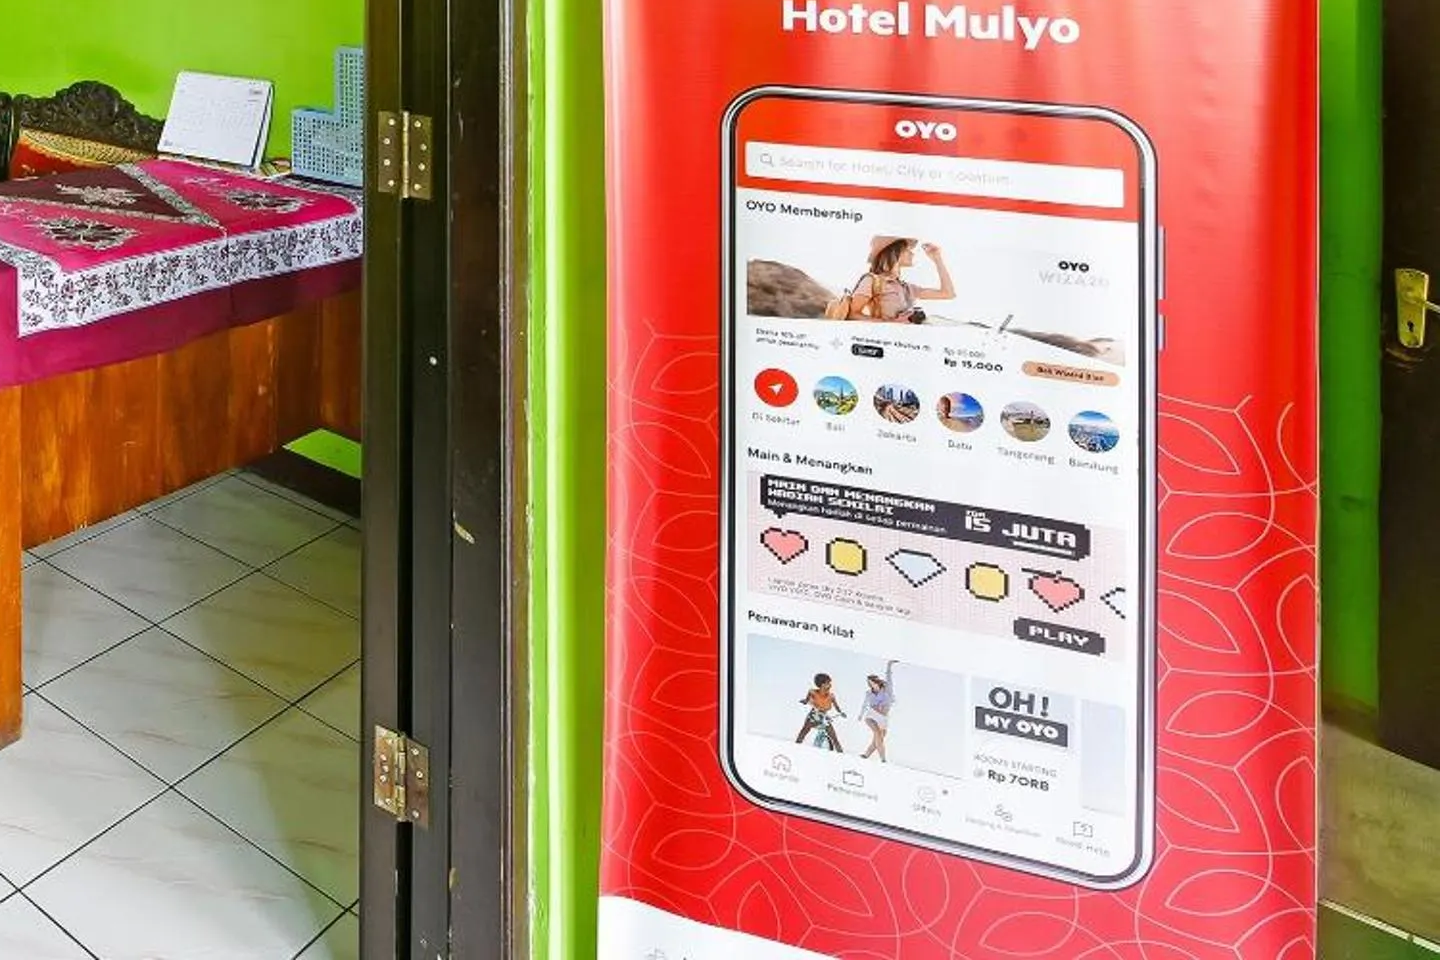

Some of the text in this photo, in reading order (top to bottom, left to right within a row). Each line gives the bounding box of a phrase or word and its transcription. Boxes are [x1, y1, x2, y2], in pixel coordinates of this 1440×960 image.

[782, 0, 1080, 50] Hotel Mulyo
[895, 120, 957, 141] OYO
[746, 199, 863, 223] OYO Membership
[1058, 260, 1090, 273] OYO
[944, 357, 1004, 373] Rp 15.000
[748, 447, 873, 476] Main & Menangkan
[997, 446, 1056, 465] Tangerang
[1068, 457, 1119, 476] Bandung
[767, 478, 936, 513] MAIN DAN MENANGKAN
[1002, 523, 1077, 548] JUTA
[748, 610, 855, 639] Penawaran Kilat
[1028, 625, 1090, 647] PLAY
[984, 713, 1060, 740] MY OYO
[988, 769, 1050, 791] Rp 70RB
